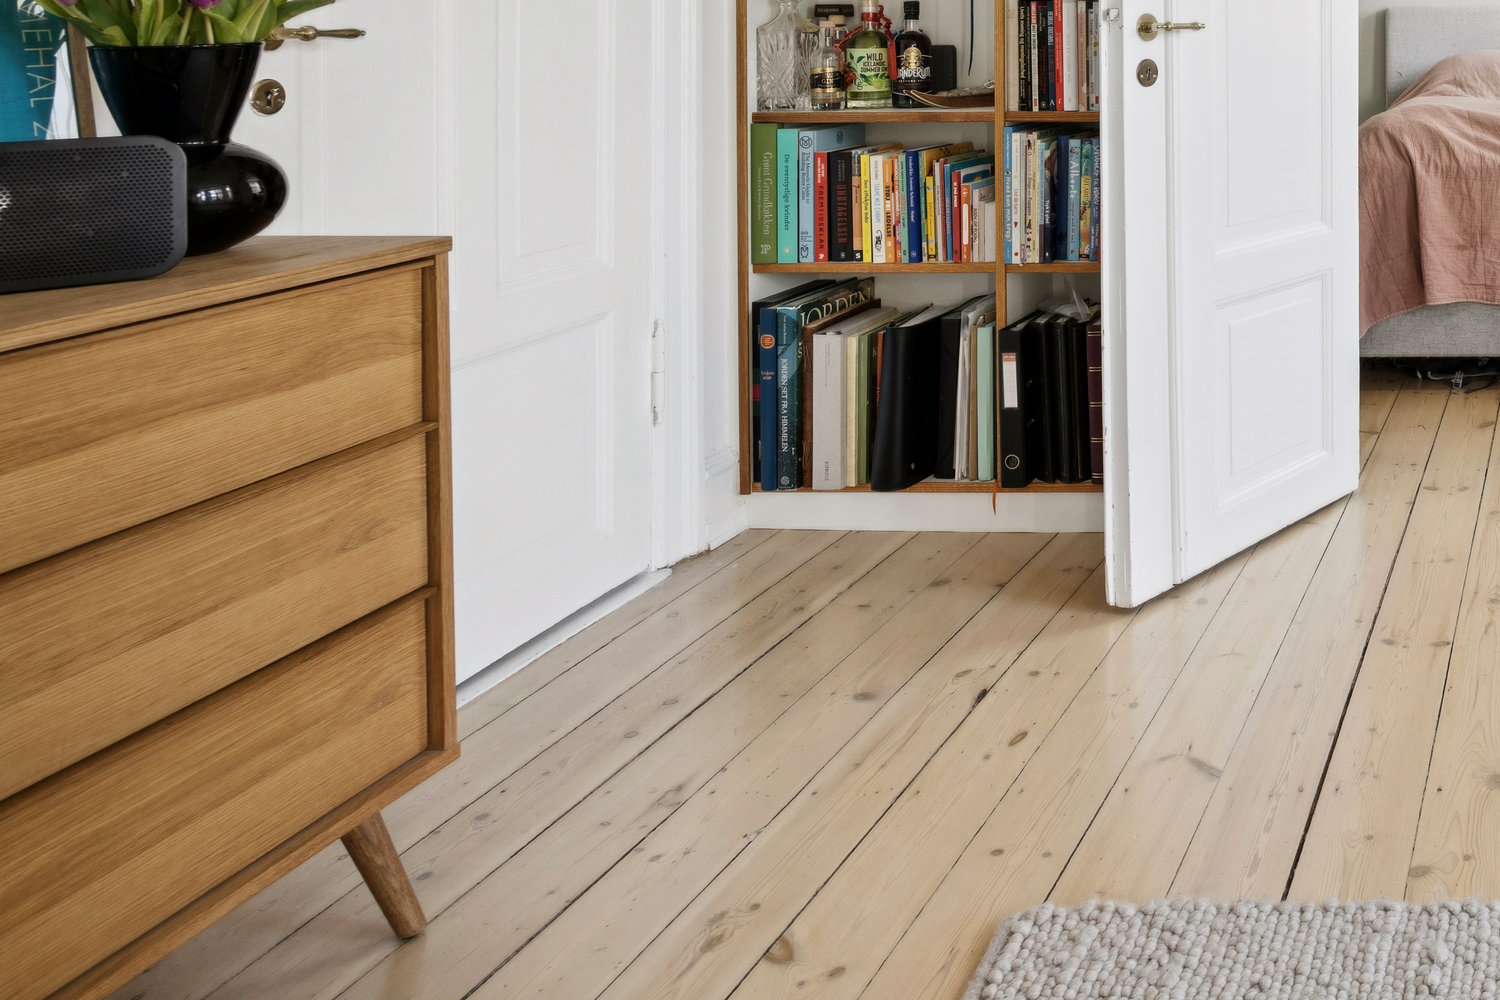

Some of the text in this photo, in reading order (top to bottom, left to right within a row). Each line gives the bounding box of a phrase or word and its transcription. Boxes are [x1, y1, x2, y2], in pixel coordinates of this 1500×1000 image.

[866, 52, 883, 61] WILD
[784, 154, 790, 164] De
[762, 151, 773, 235] Grønt Grundkøkken
[782, 165, 790, 203] eventyrlige
[836, 184, 848, 244] UNDTAGELSEN
[1004, 223, 1012, 242] krop?
